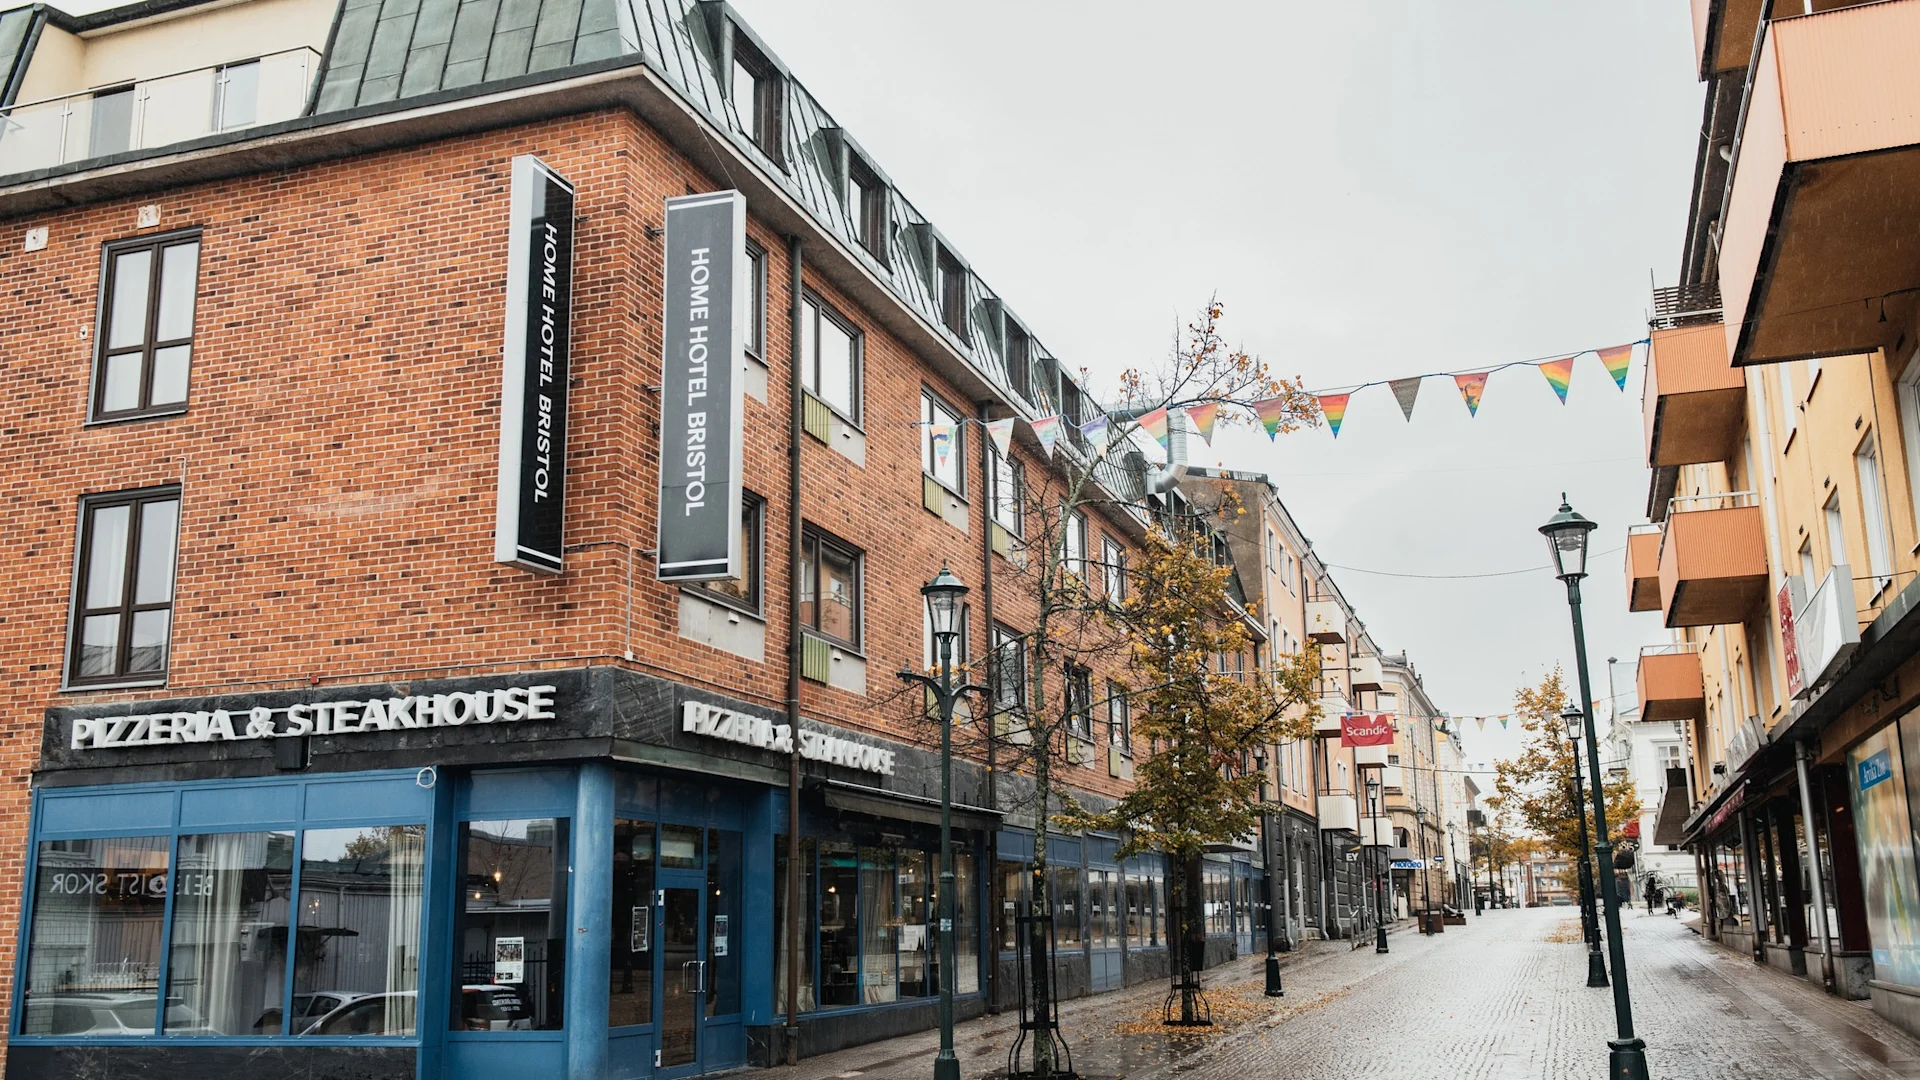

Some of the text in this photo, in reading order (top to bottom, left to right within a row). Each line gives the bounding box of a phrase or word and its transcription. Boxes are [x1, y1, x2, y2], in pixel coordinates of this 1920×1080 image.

[534, 221, 558, 504] HOME HOTEL BRISTOL
[685, 247, 710, 517] HOME HOTEL BRISTOL
[71, 684, 557, 750] PIZZERIA & STEAKHOUSE
[682, 700, 896, 776] PIZZERIA & STEAKHOUSE
[1346, 725, 1388, 737] Scandic
[1346, 852, 1359, 861] EY
